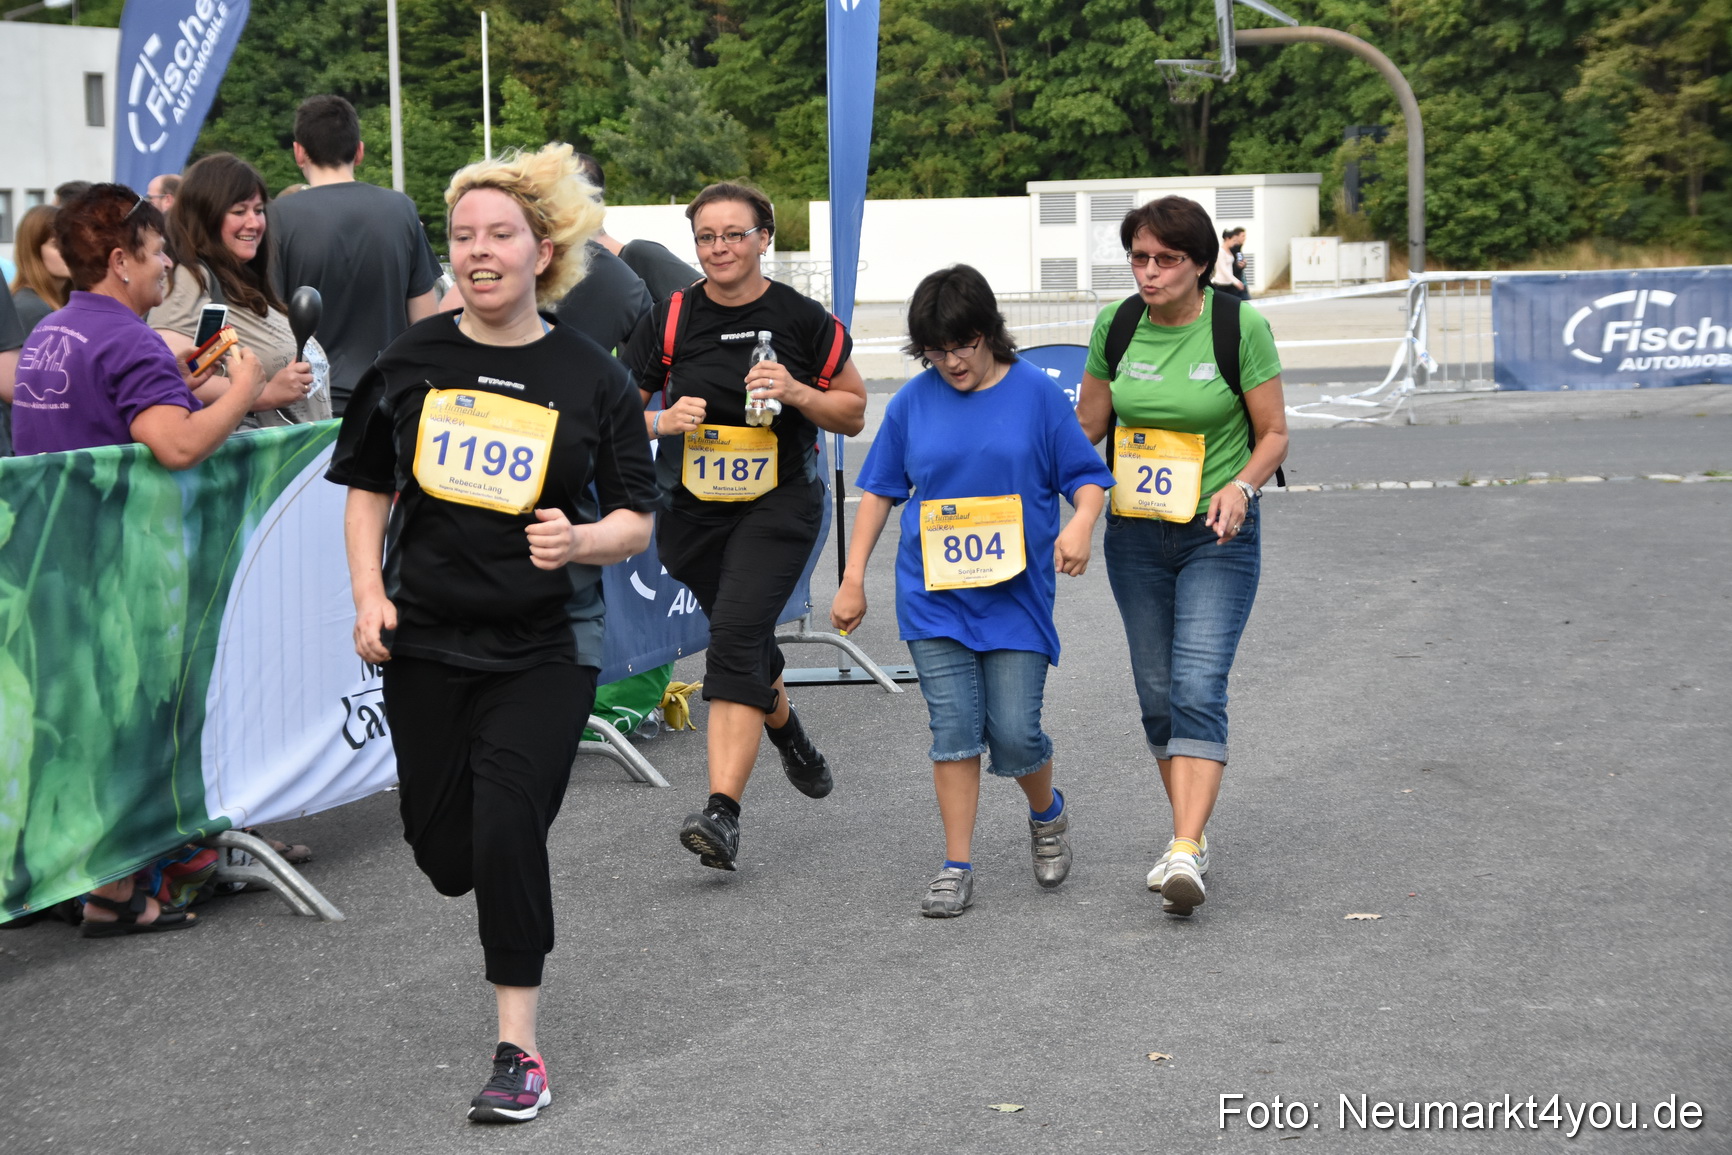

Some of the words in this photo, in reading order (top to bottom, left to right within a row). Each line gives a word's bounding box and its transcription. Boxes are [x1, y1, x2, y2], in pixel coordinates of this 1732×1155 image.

[145, 0, 218, 126] Fische
[172, 1, 228, 124] AUTOMOBILE
[1617, 353, 1732, 372] AUTOMOB
[432, 430, 534, 482] 1198
[693, 455, 769, 482] 1187
[449, 476, 482, 489] Rebecca
[483, 484, 503, 495] Lang
[1136, 465, 1172, 495] 26
[1138, 499, 1151, 507] Olga
[1151, 500, 1167, 508] Frank
[943, 531, 1005, 563] 804
[667, 588, 702, 617] AU
